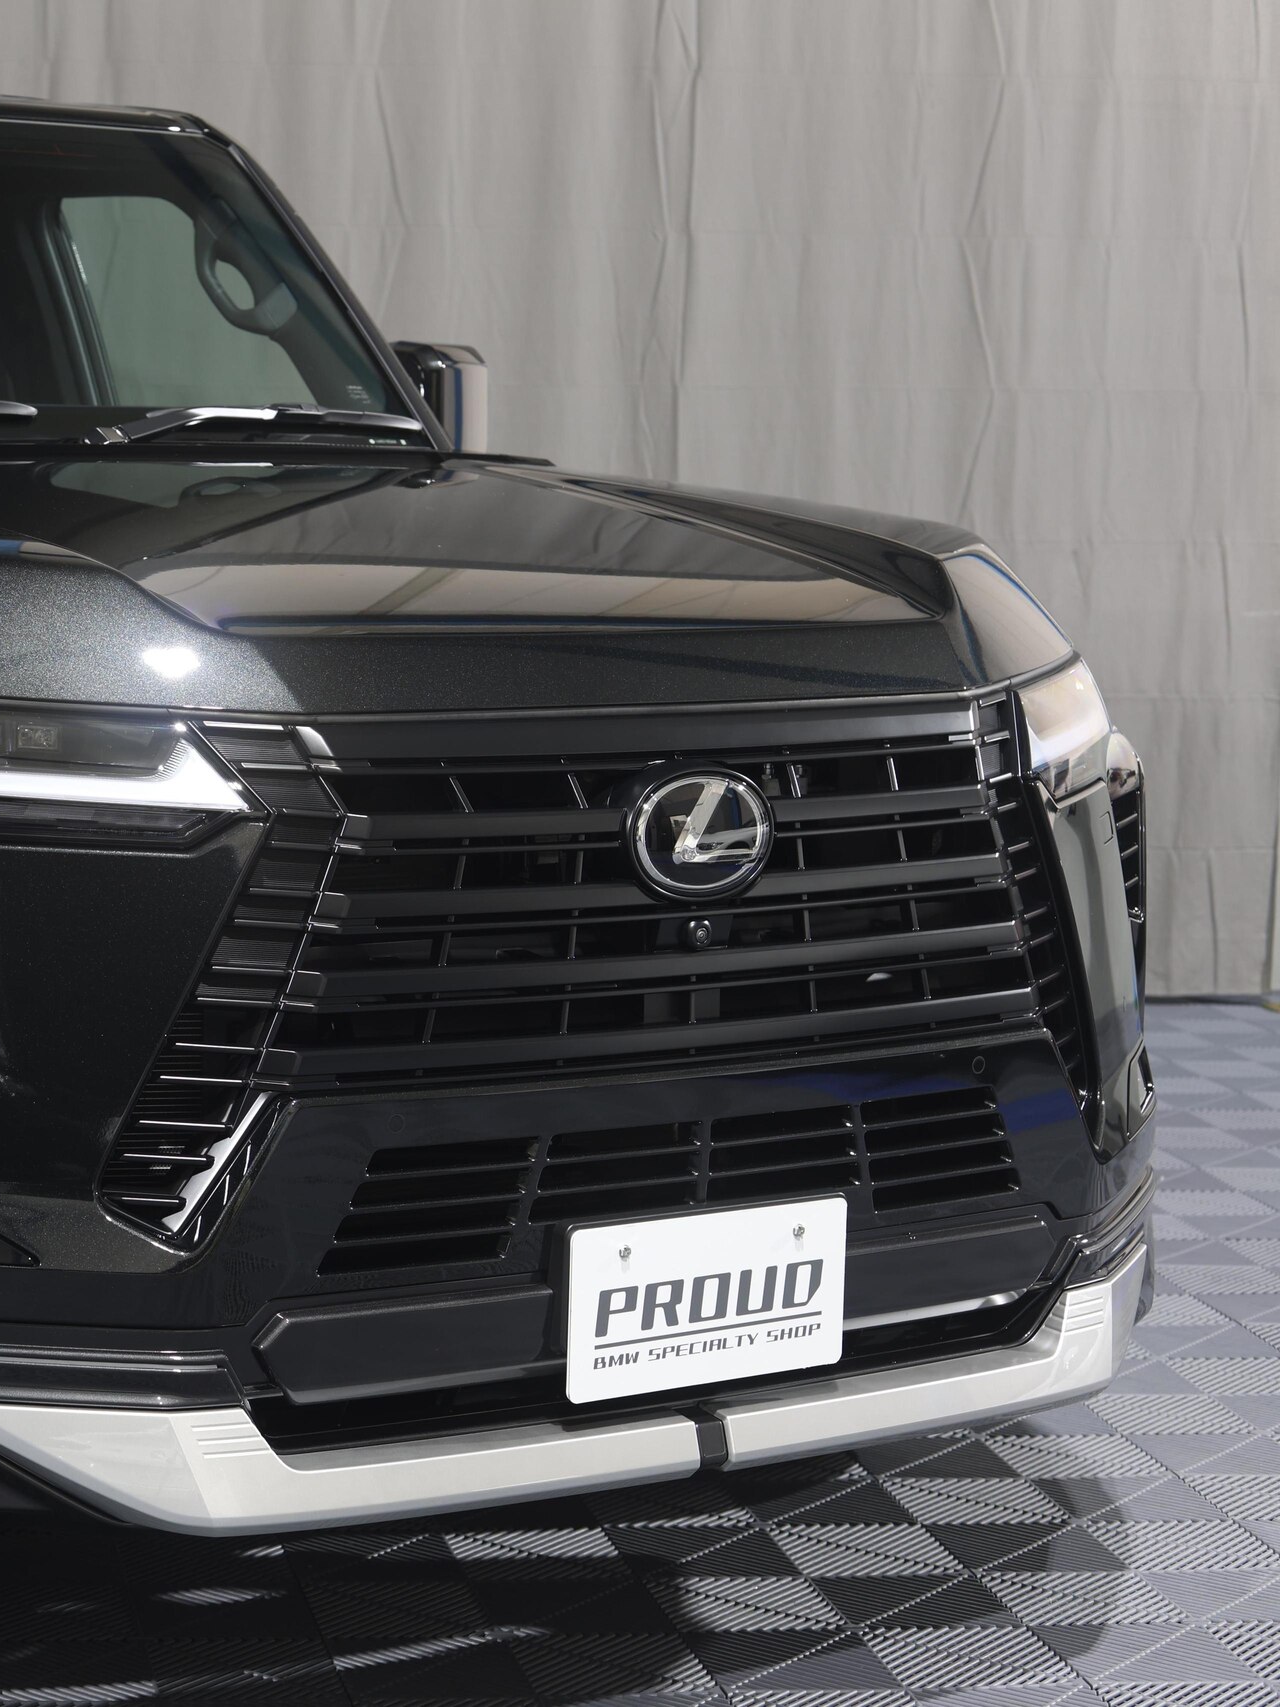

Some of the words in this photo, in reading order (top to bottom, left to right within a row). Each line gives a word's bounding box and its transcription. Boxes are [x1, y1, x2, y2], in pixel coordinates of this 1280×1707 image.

[594, 1258, 824, 1338] PROUD
[593, 1351, 640, 1370] BMW
[648, 1332, 759, 1362] SPECIALTY
[766, 1323, 822, 1342] SHOP
